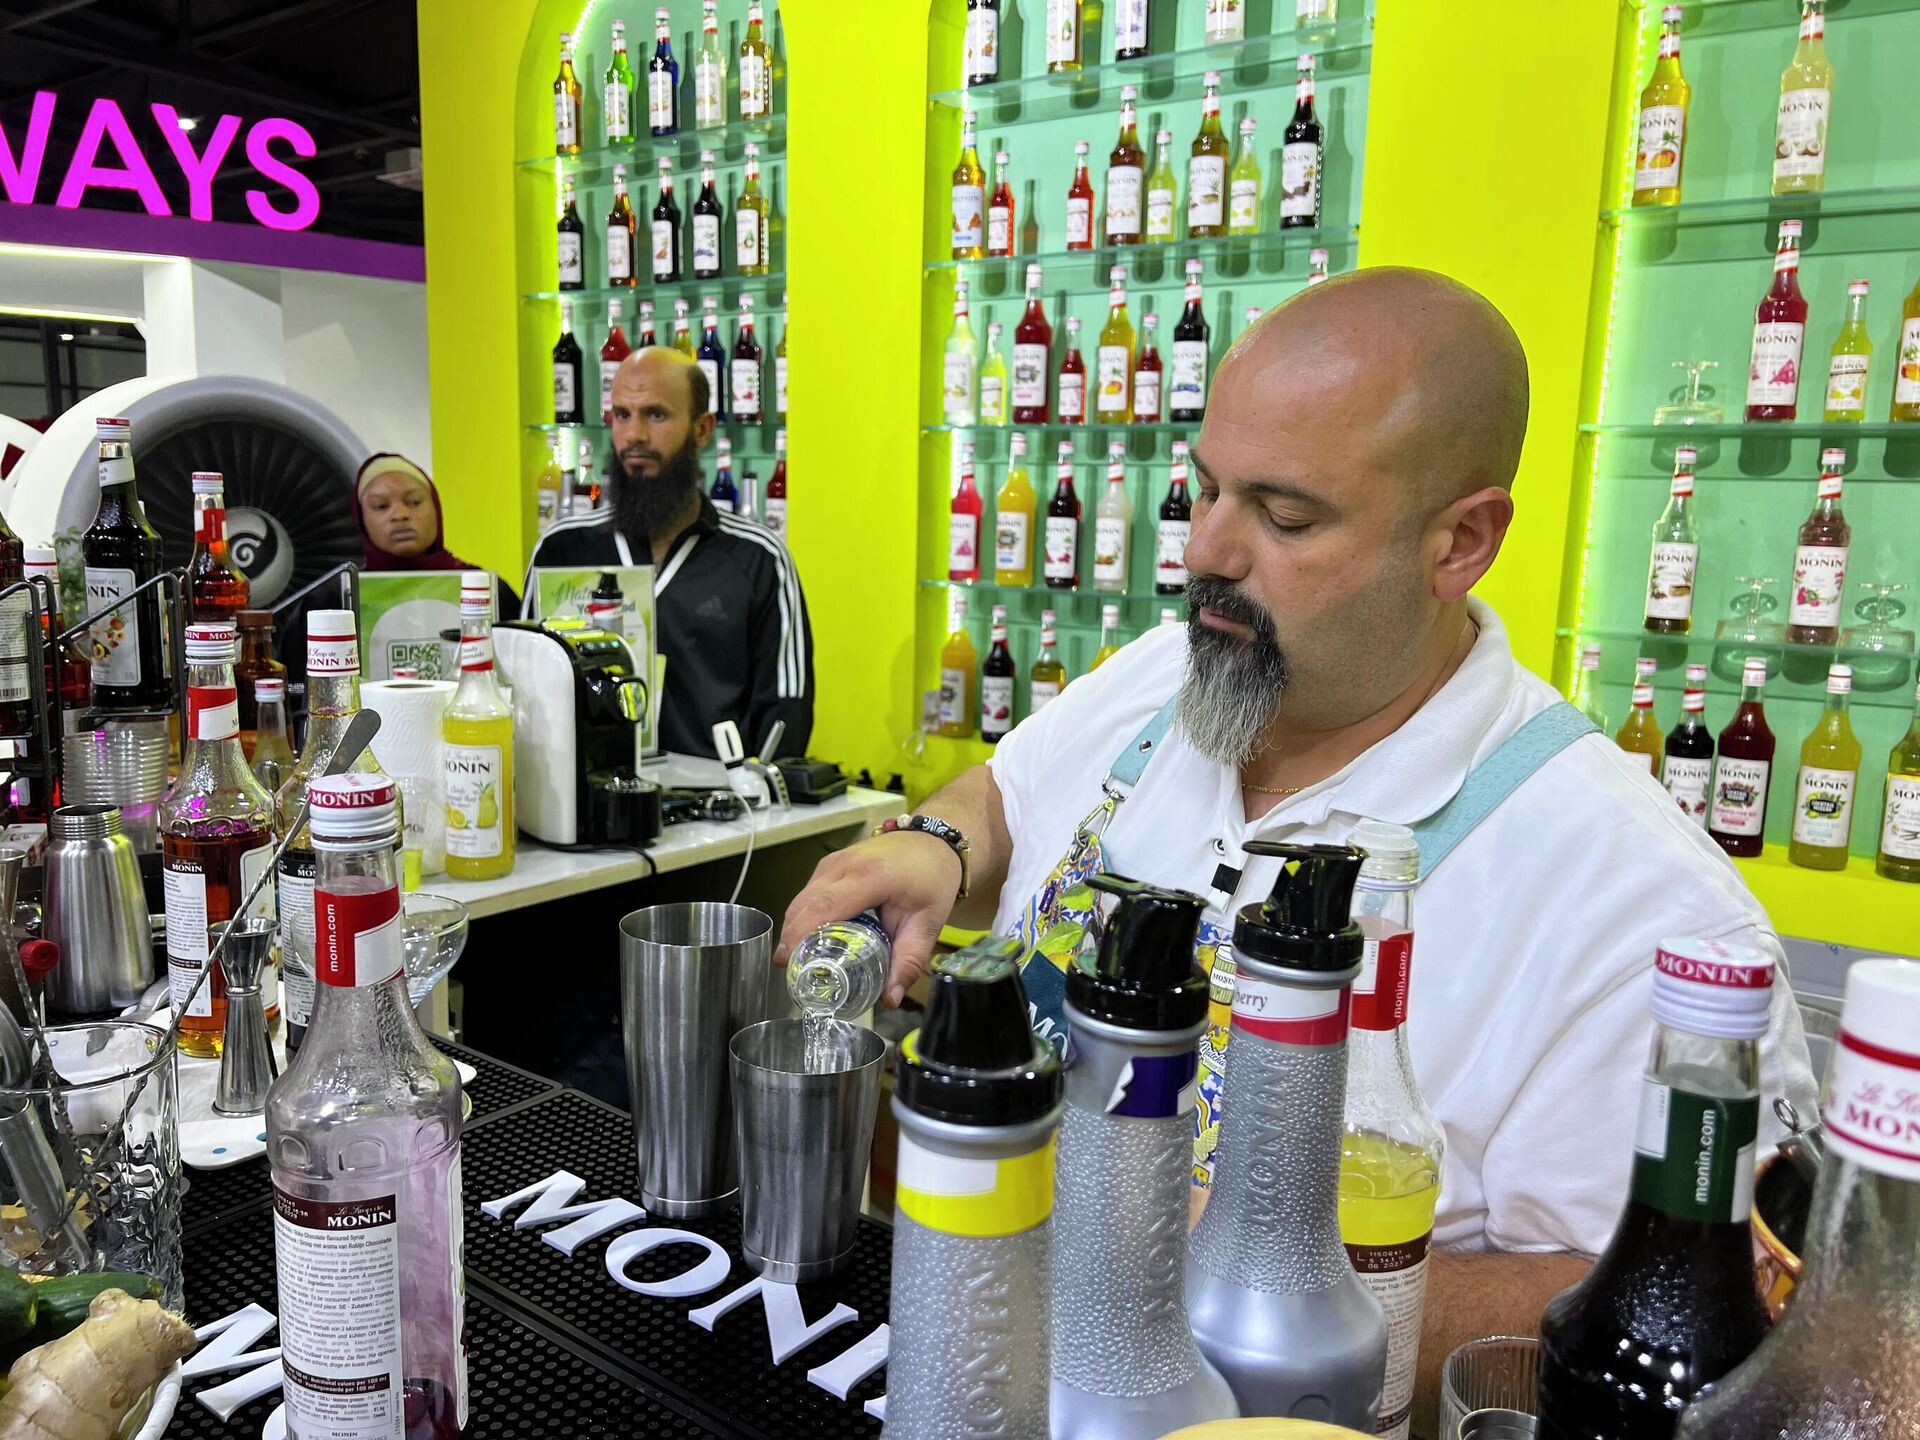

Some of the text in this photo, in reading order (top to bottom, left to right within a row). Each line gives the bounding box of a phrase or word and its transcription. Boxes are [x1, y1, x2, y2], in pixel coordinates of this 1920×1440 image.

[1800, 557, 1843, 568] MONIN
[1668, 768, 1709, 779] MONIN
[1720, 768, 1761, 780] MONIN
[1804, 778, 1849, 790] MONIN
[311, 791, 376, 807] MONIN
[172, 863, 202, 872] MONIN
[326, 903, 339, 972] monin.com
[1658, 953, 1752, 985] MONIN
[1394, 951, 1408, 1018] monin.com
[1695, 1108, 1716, 1206] monin.com
[327, 1210, 392, 1227] MONIN
